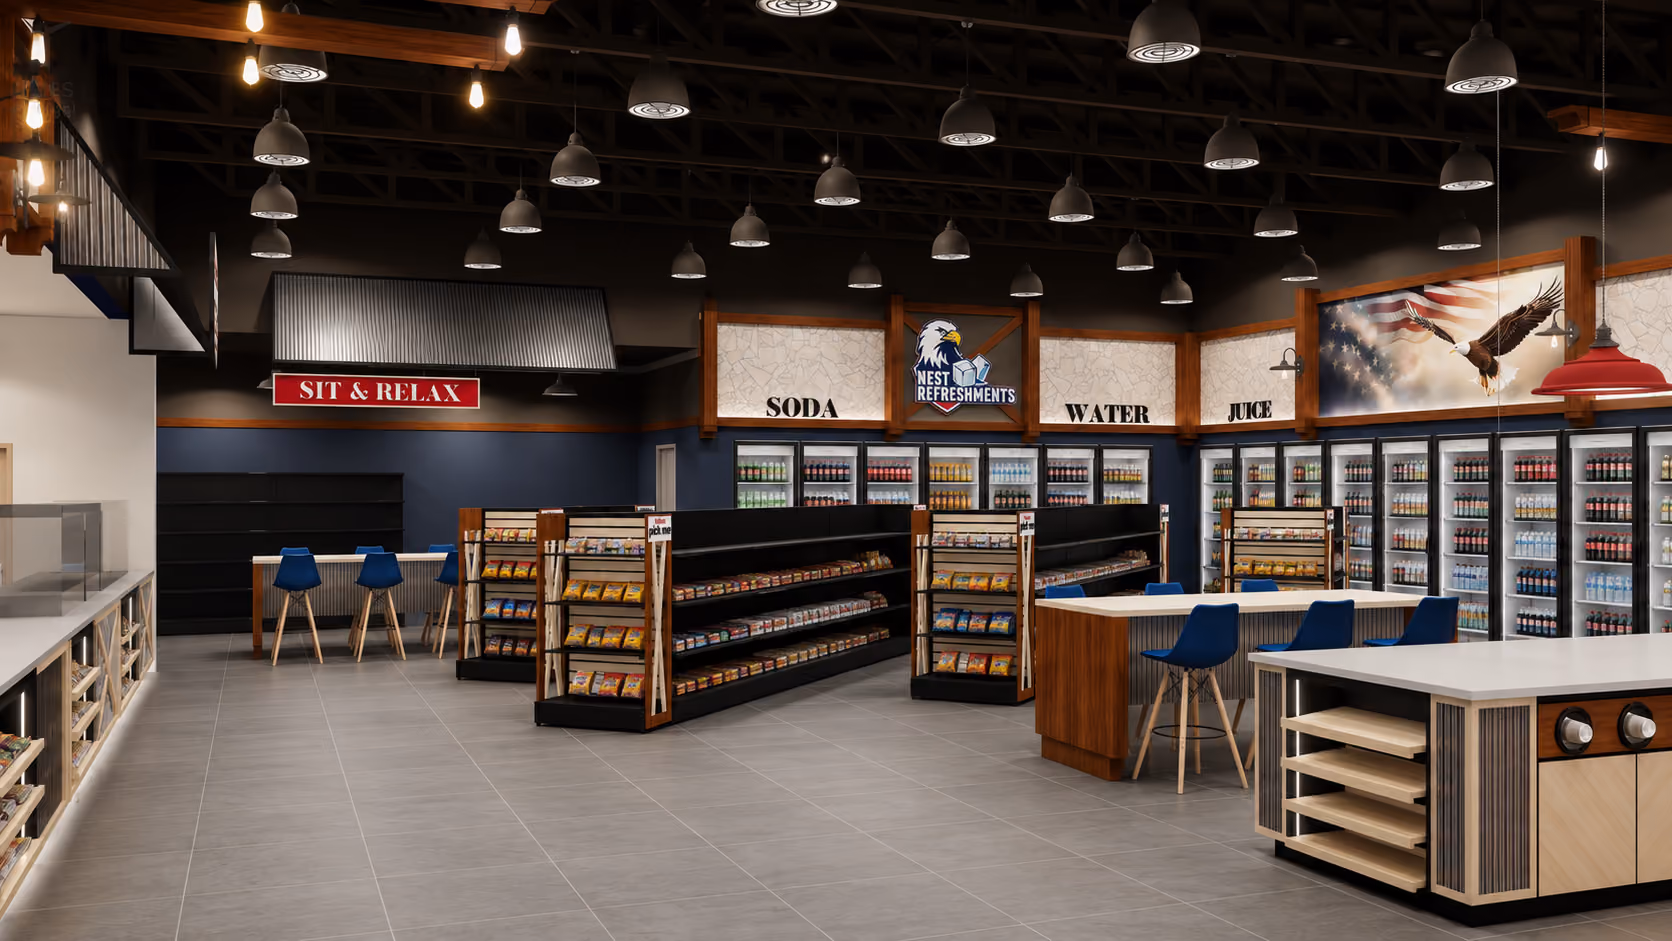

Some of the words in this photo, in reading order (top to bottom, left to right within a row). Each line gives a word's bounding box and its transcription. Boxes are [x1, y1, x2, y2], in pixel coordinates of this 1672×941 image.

[917, 370, 950, 386] NEST
[300, 380, 342, 400] SIT
[350, 381, 368, 400] &
[376, 382, 461, 402] RELAX
[917, 386, 1016, 403] REFRESHMENTS
[766, 396, 839, 418] SODA
[1065, 403, 1150, 423] WATER
[1227, 400, 1272, 422] JUICE
